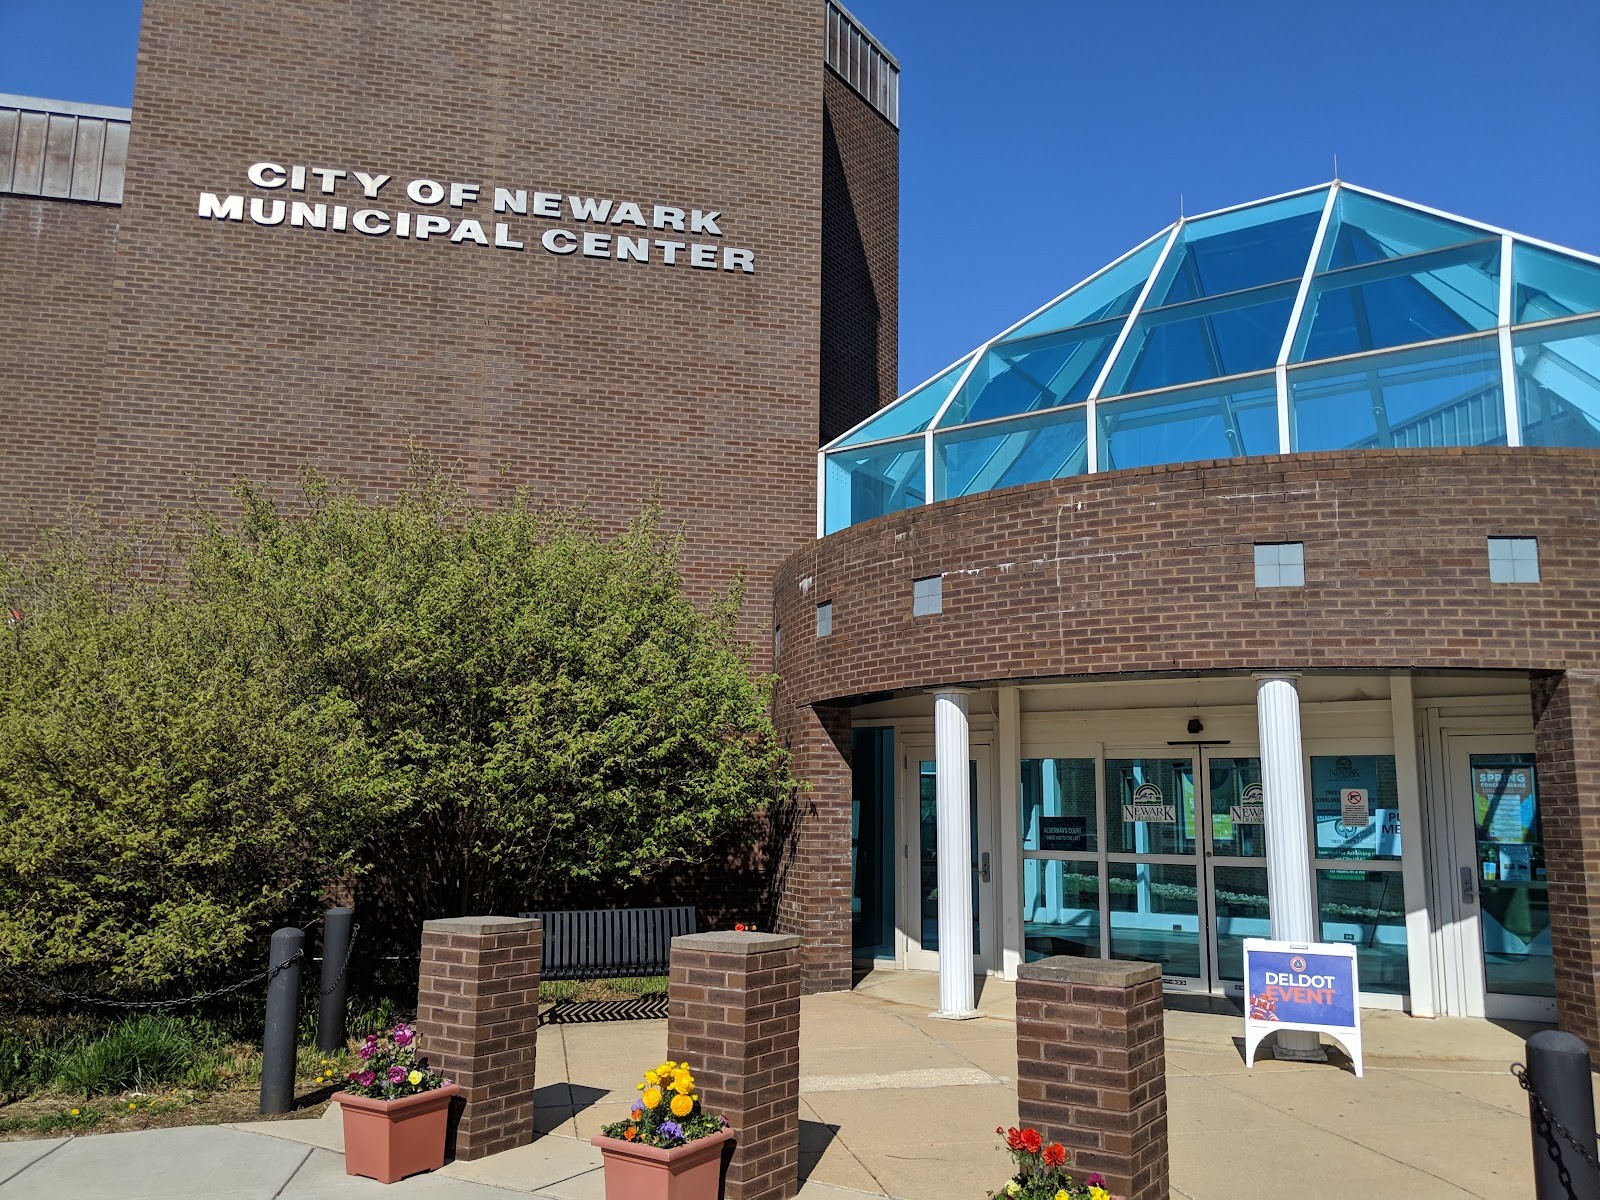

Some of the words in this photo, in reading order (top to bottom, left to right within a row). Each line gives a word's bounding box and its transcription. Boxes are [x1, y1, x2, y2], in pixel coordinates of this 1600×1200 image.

[247, 162, 392, 200] CITY
[406, 179, 480, 207] OF
[494, 187, 723, 237] NEWARK
[198, 192, 524, 250] MUNICIPAL
[541, 228, 755, 274] CENTER
[1480, 774, 1526, 782] SPRING
[1124, 806, 1174, 820] NEWARK
[1232, 807, 1264, 822] NEWA
[1266, 972, 1335, 988] DELDOT
[1265, 986, 1336, 1005] EVENT
